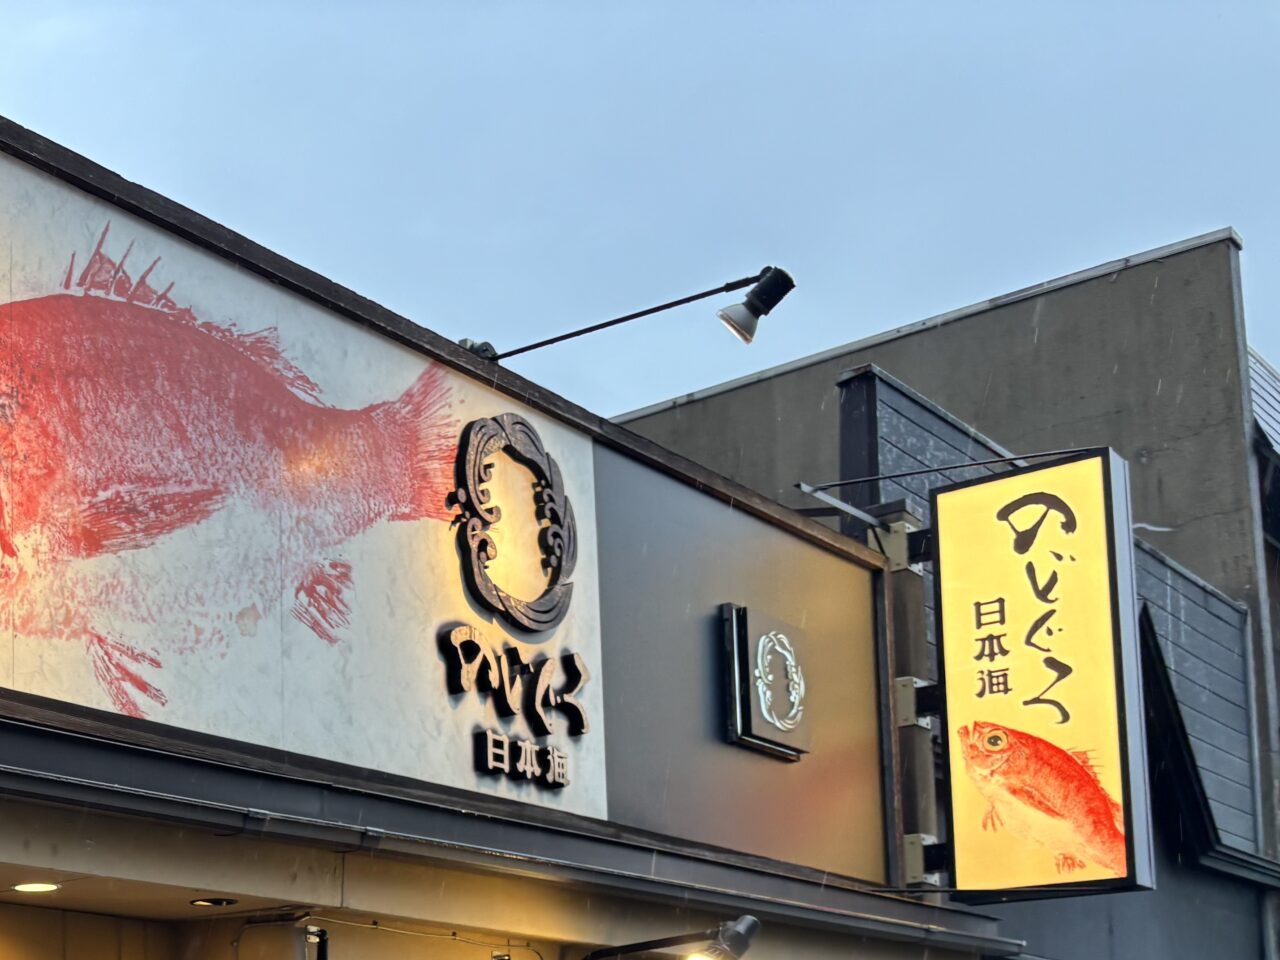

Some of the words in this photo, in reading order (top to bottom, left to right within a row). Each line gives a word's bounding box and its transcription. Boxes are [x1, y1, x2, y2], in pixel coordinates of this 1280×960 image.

[973, 597, 1013, 698] 日本海
[996, 491, 1077, 725] のどぐろ
[480, 729, 570, 788] 日本海
